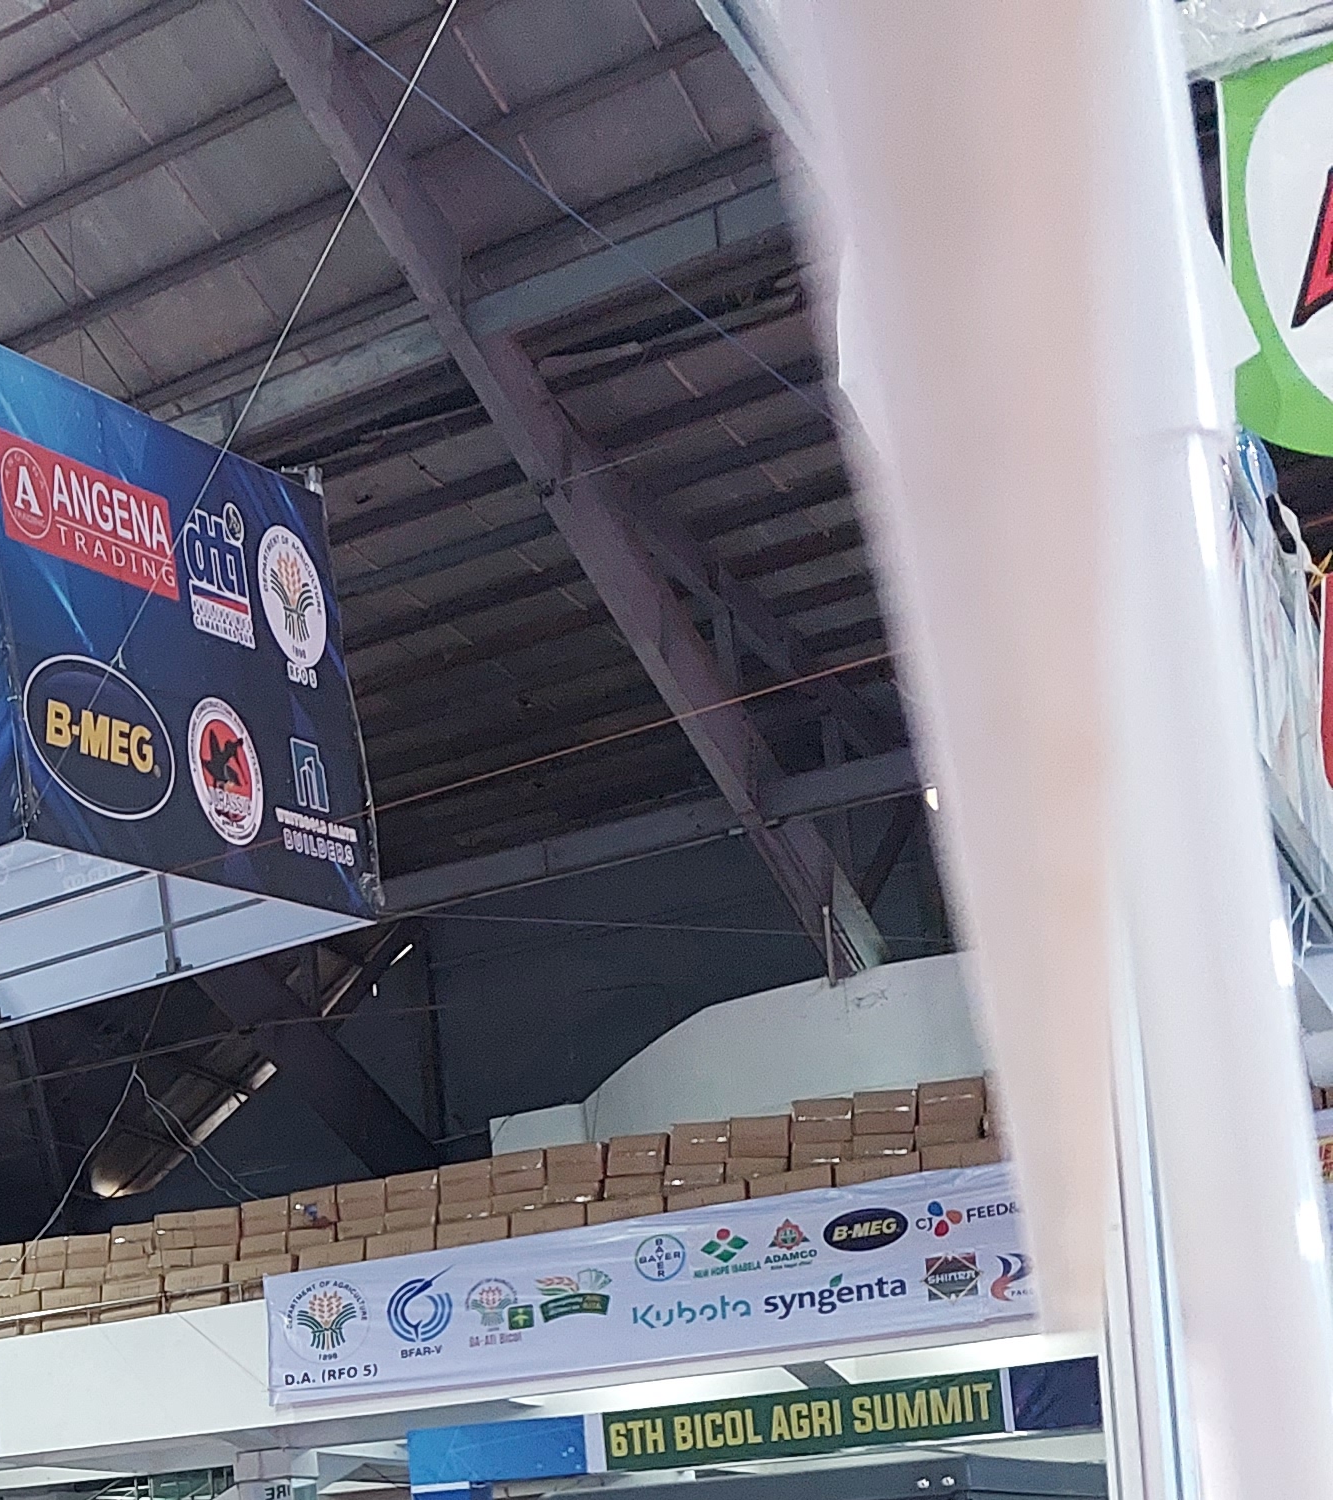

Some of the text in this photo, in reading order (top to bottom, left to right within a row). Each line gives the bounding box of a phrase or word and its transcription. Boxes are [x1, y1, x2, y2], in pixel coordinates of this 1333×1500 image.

[53, 464, 171, 556] ANGENA
[56, 523, 177, 588] TRADING
[45, 698, 154, 774] B-MEG
[283, 828, 356, 868] BUILDERS
[833, 1217, 898, 1242] B-MEG
[915, 1217, 933, 1232] CJ
[639, 1250, 682, 1265] BAYER
[654, 1237, 666, 1278] BAYER
[710, 1265, 731, 1277] HOPE
[764, 1248, 818, 1266] ADAMCO
[286, 1279, 369, 1330] DEPARTMENT OF AGRICULTURE
[764, 1275, 908, 1320] syngenta
[400, 1345, 443, 1360] BFAR-V
[284, 1362, 379, 1387] D.A. (RFO 5)
[609, 1382, 993, 1458] 6TH BICOL AGRI SUMMIT
